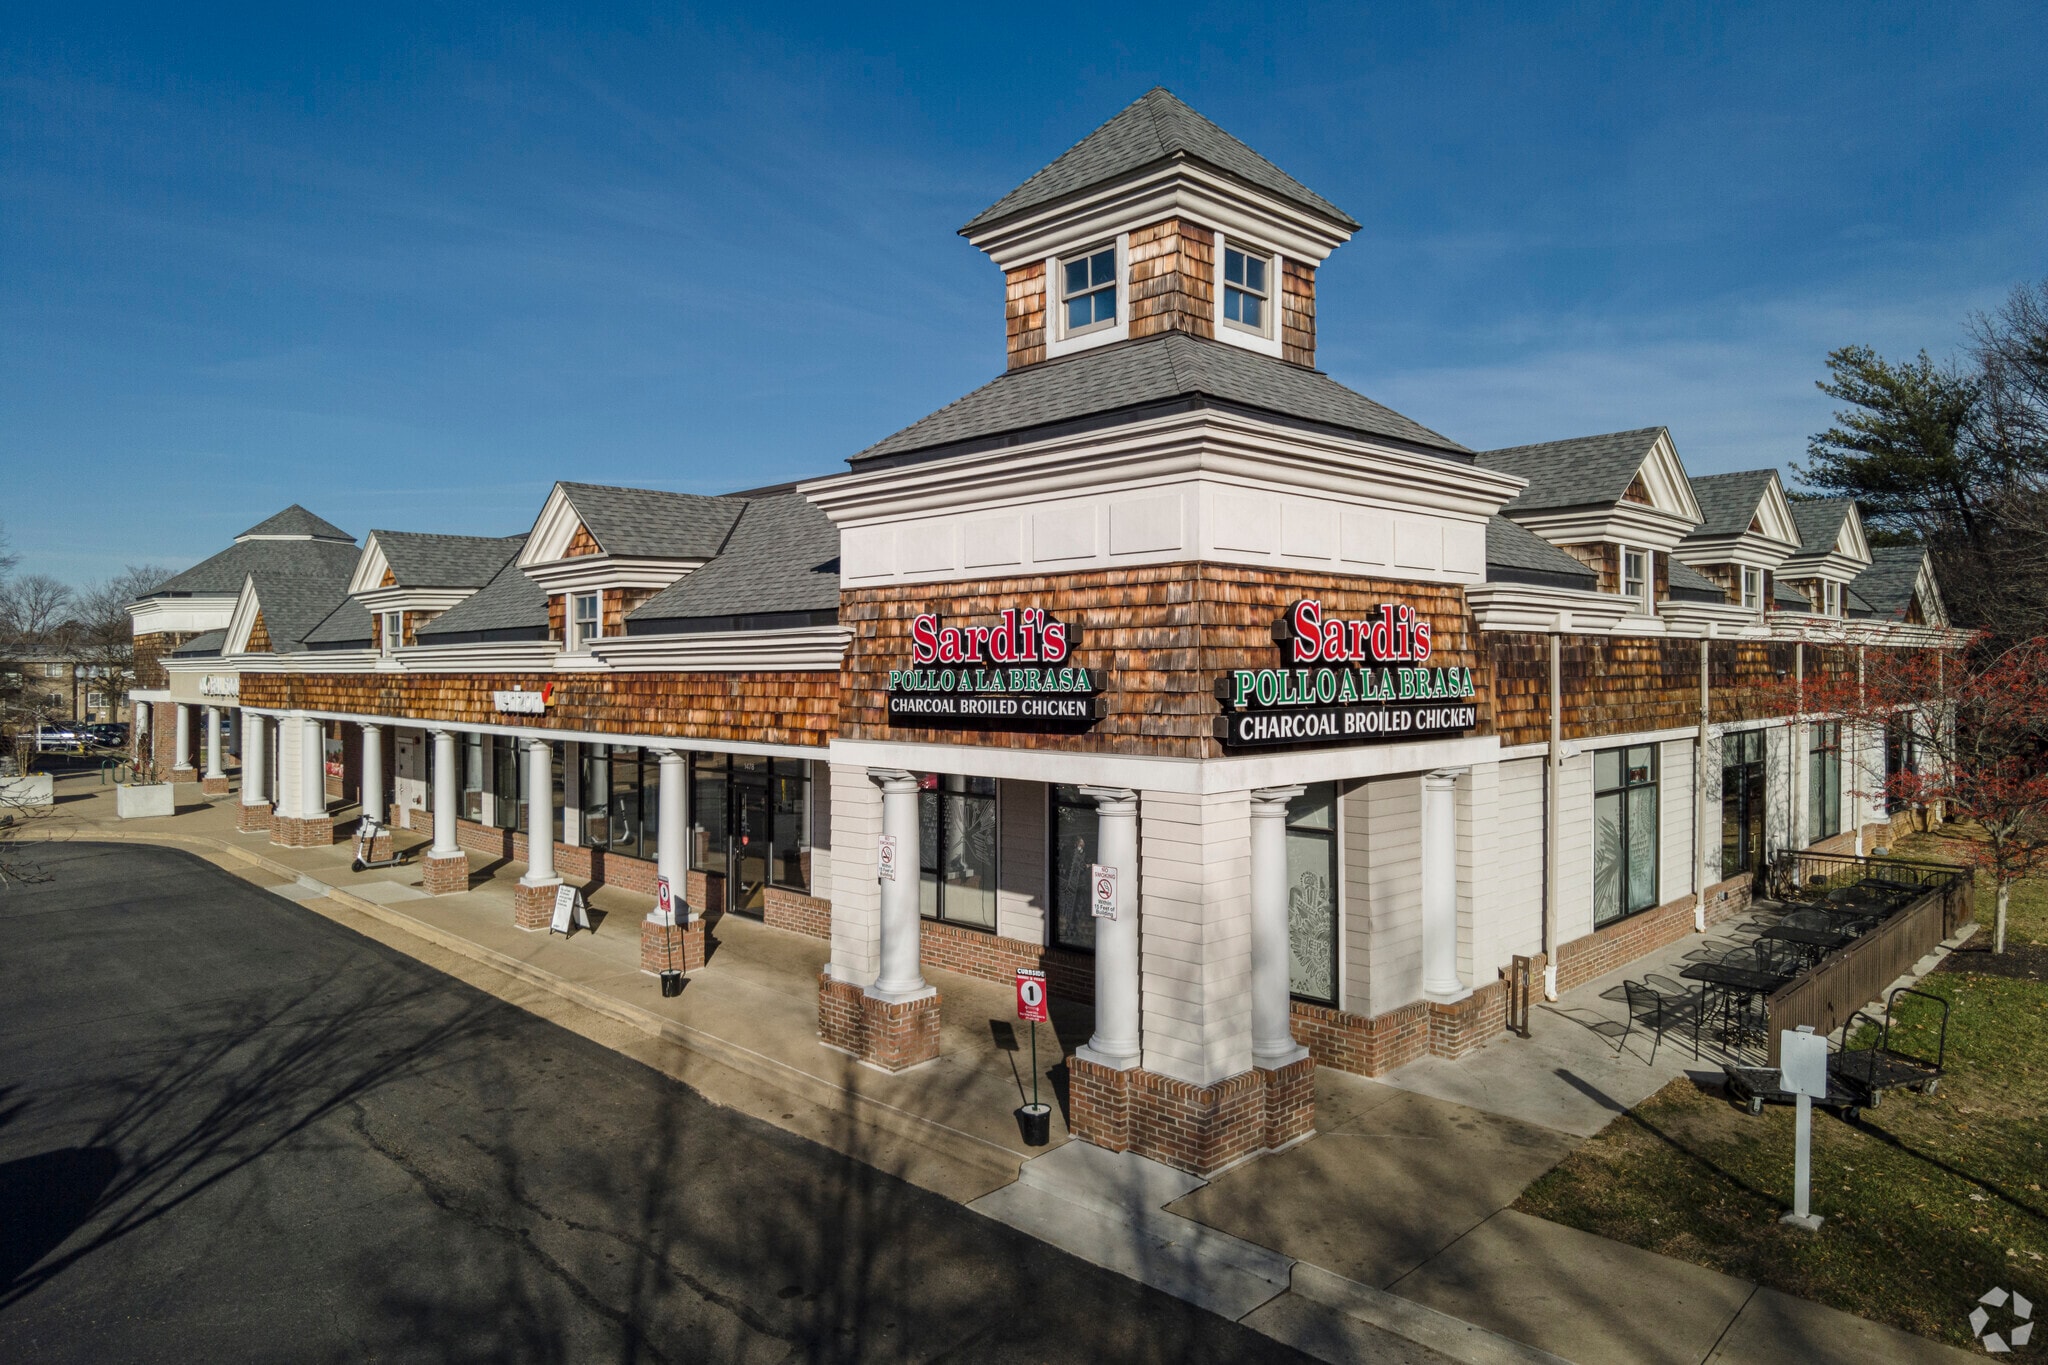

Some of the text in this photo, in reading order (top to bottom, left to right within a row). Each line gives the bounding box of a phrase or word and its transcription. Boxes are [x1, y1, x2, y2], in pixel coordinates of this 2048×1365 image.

[913, 607, 1066, 664] Sardi's
[1293, 599, 1431, 662] Sardi's
[889, 668, 1092, 692] POLLO A LA BRASA
[1234, 666, 1475, 707] POLLO A LA BRASA
[891, 698, 1086, 716] CHARCOAL BROILED CHICKEN
[1240, 707, 1475, 740] CHARCOAL BROILED CHICKEN
[1028, 986, 1034, 1001] 1
